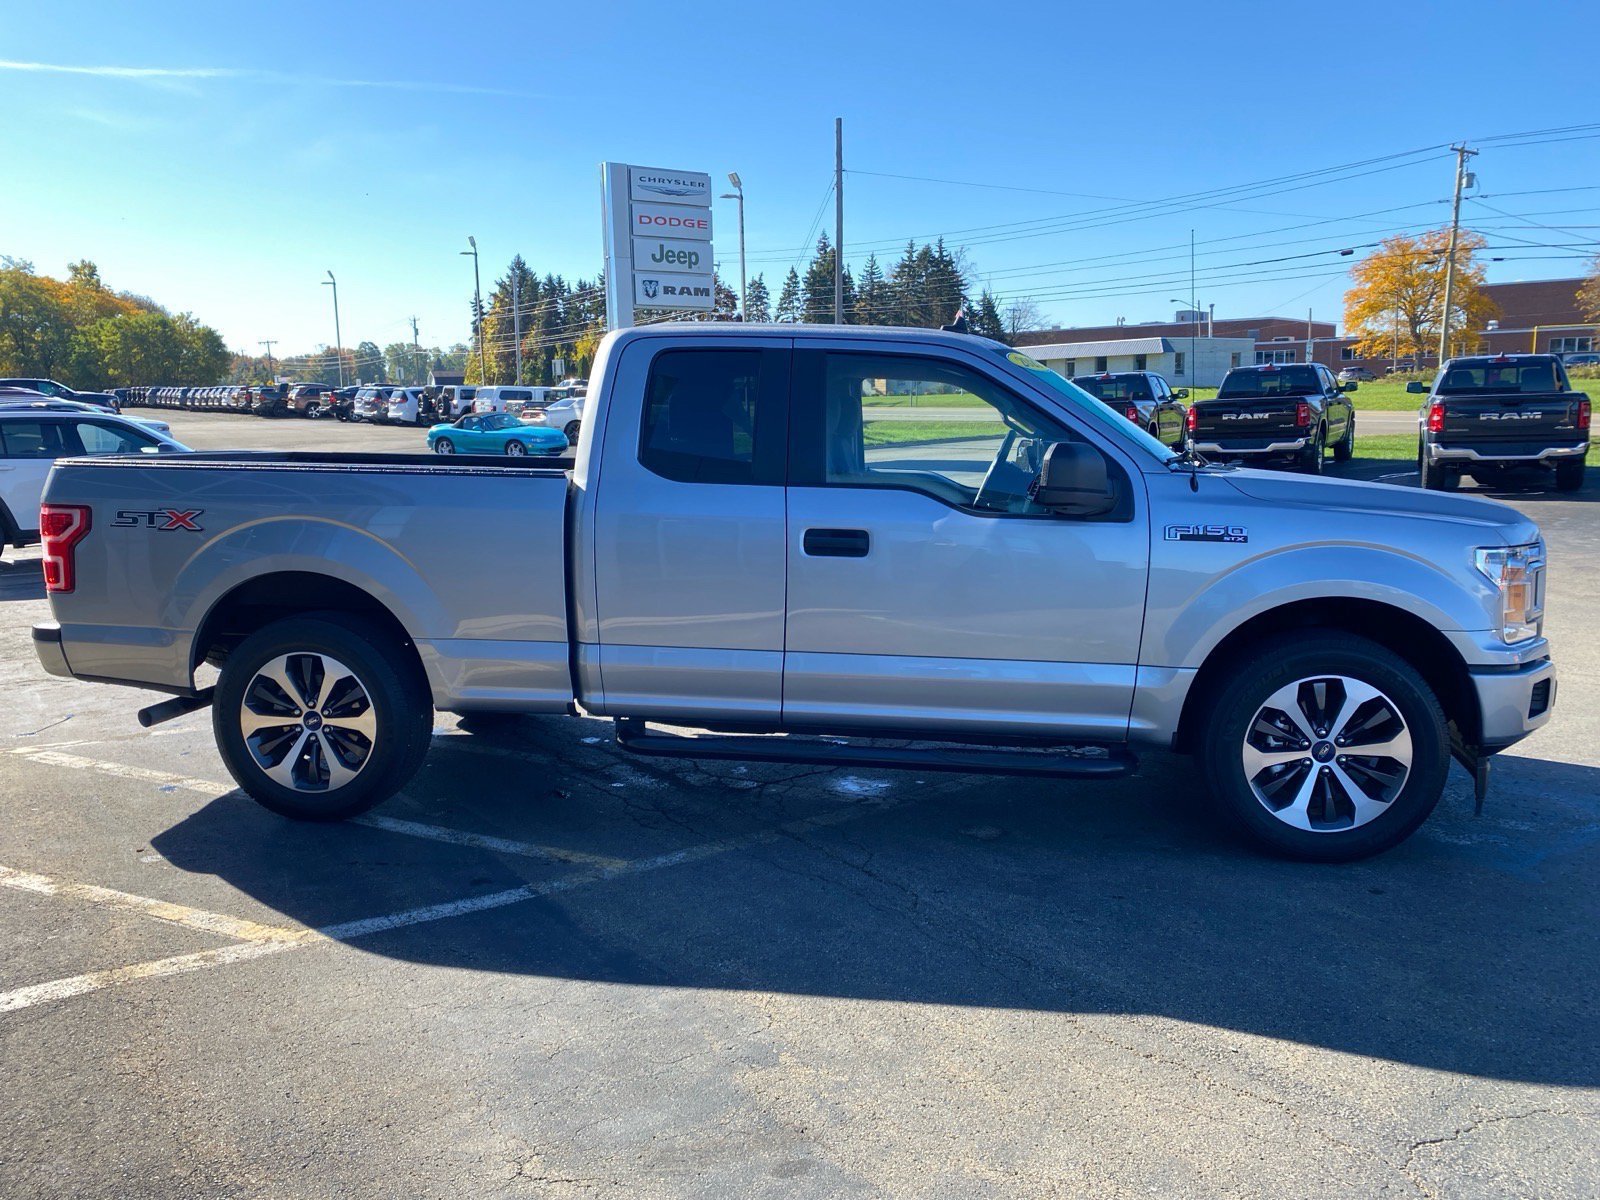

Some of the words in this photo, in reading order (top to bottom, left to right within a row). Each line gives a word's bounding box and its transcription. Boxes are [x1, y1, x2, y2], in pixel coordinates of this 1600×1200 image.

[639, 176, 705, 188] CHRYSLER
[638, 215, 708, 229] DODGE
[651, 244, 700, 269] Jeep
[663, 285, 710, 297] RAM
[1479, 411, 1542, 420] RAM
[110, 507, 204, 532] STX
